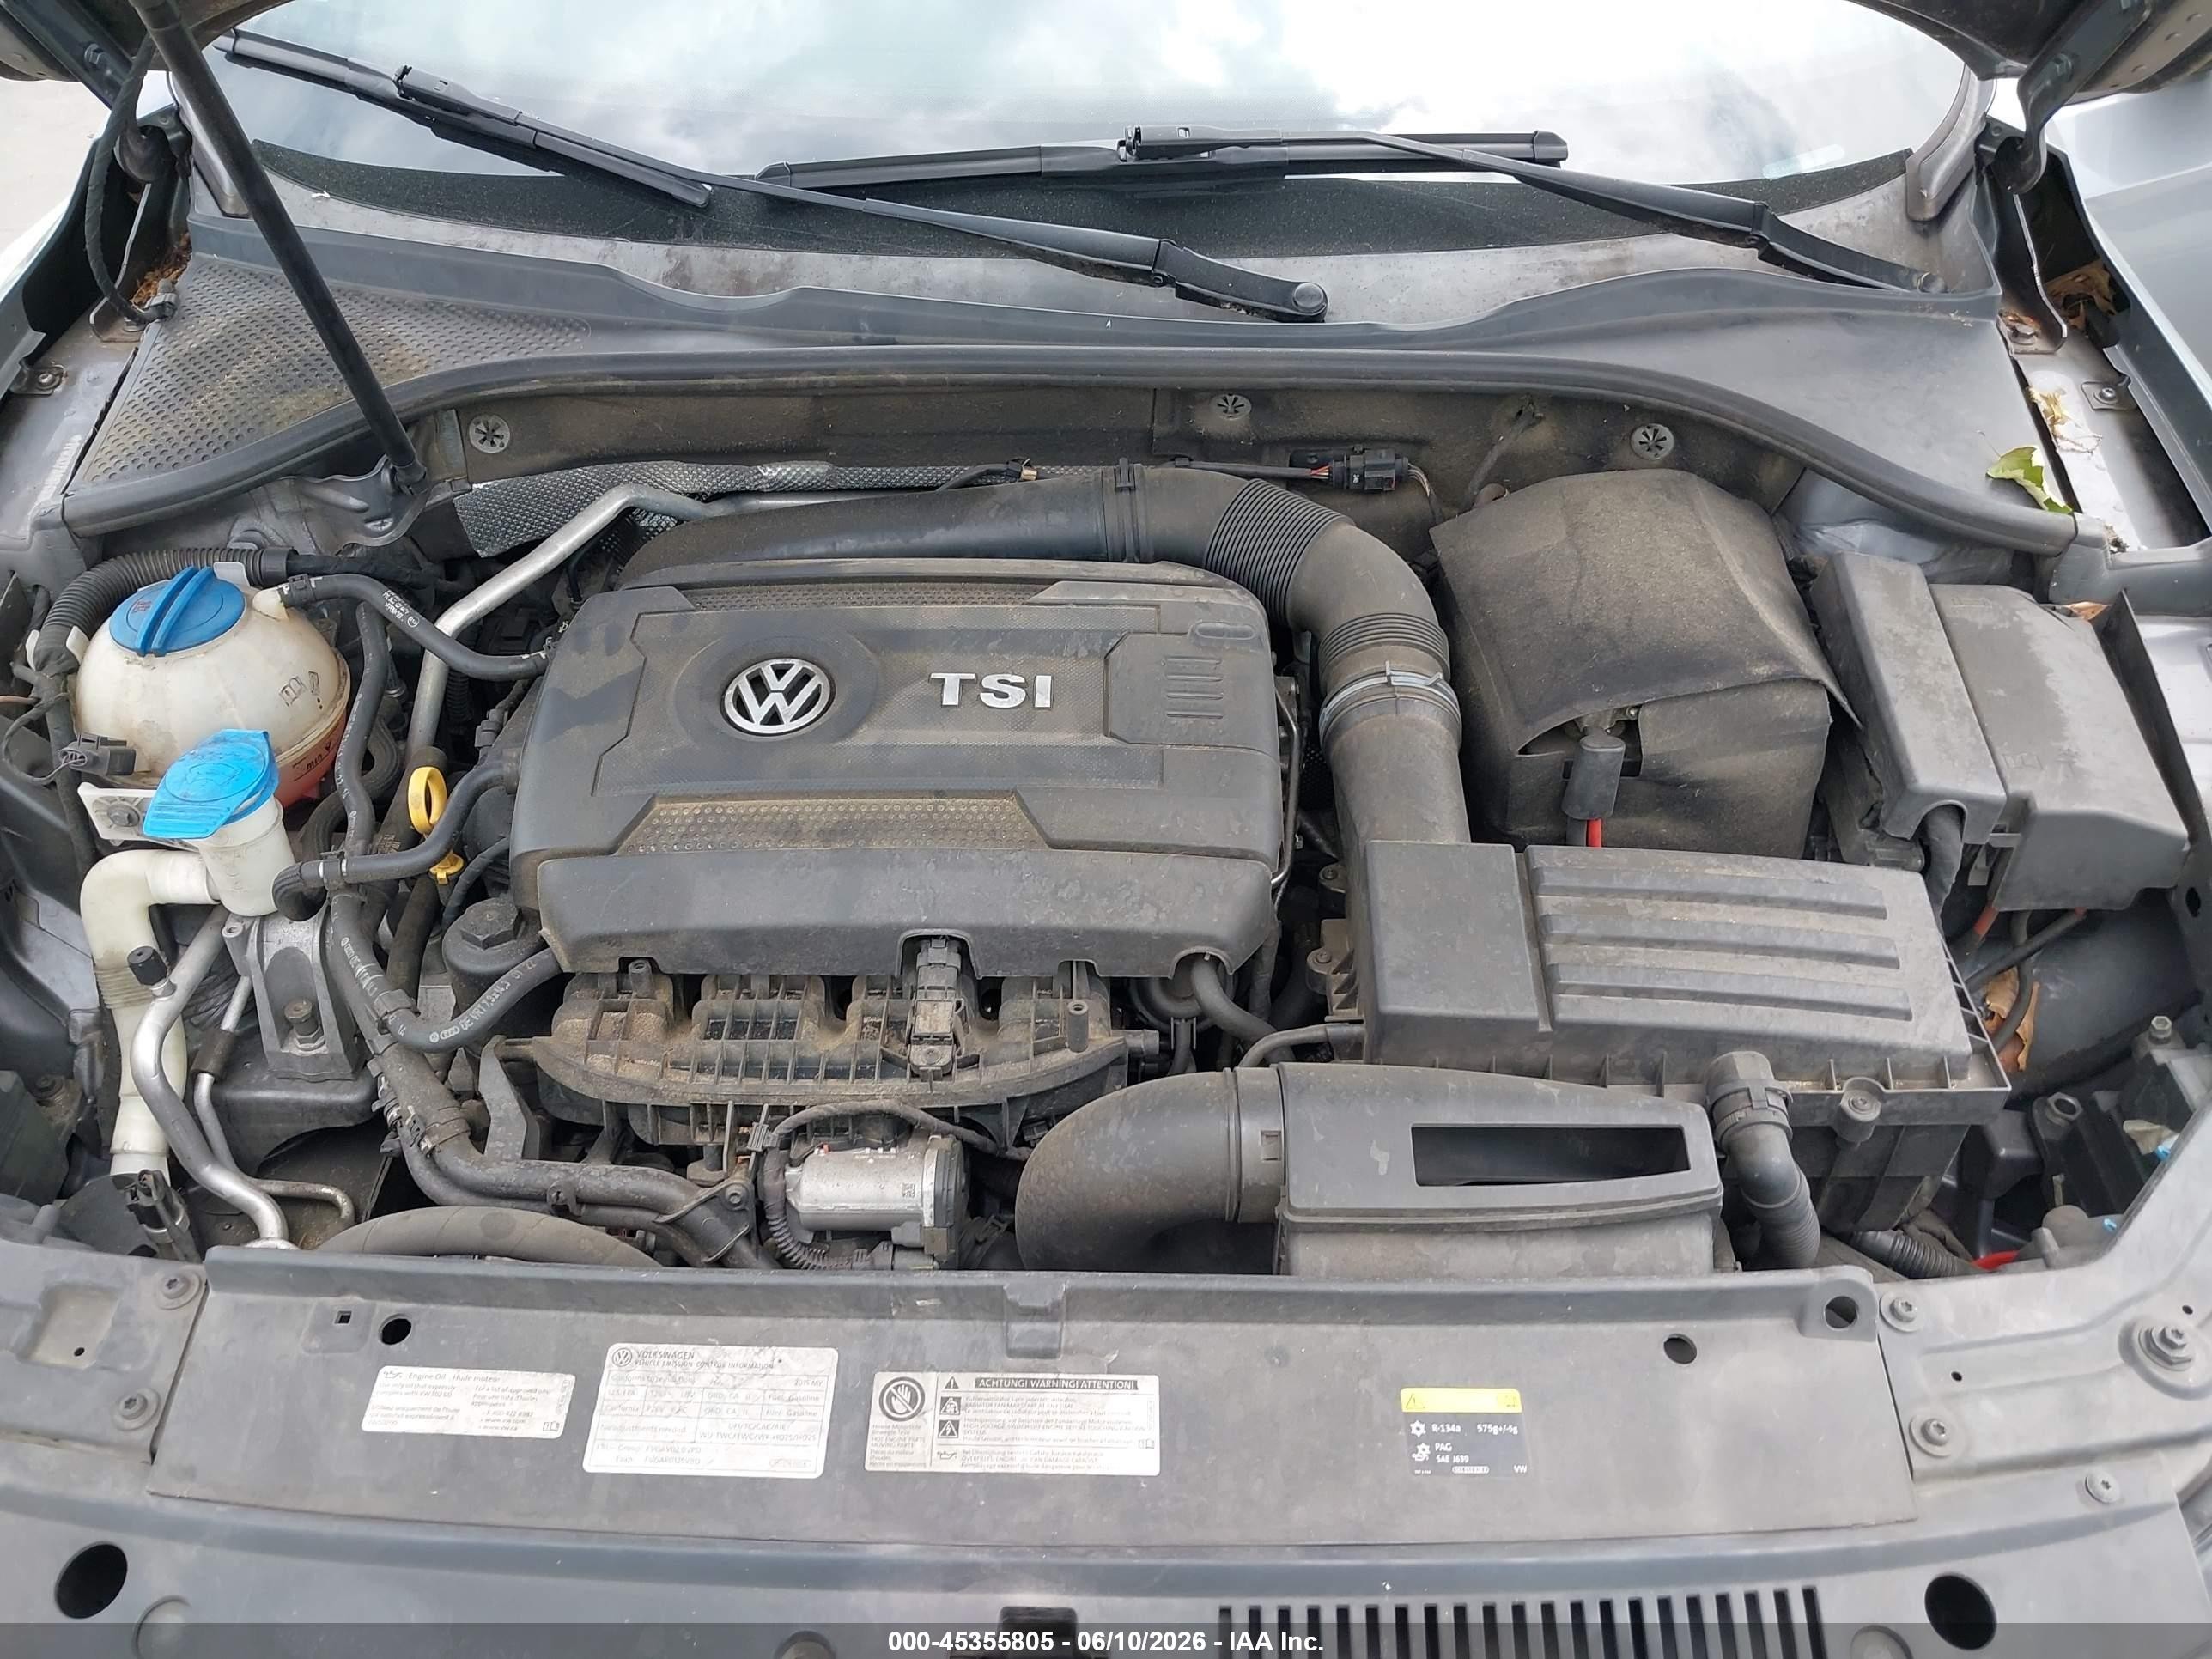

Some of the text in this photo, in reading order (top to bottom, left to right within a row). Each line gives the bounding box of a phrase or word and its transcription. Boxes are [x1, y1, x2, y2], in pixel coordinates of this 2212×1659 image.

[931, 672, 1054, 709] TSI
[635, 1351, 695, 1360] VOLKSWAGEN
[408, 1372, 434, 1381] Engine
[979, 1378, 1135, 1390] ACHTUNG! WARNING! ATTENTION!
[1431, 1423, 1462, 1433] R-134a
[1434, 1442, 1453, 1453] PAG
[1436, 1455, 1450, 1464] SAE
[1513, 1464, 1528, 1474] VW
